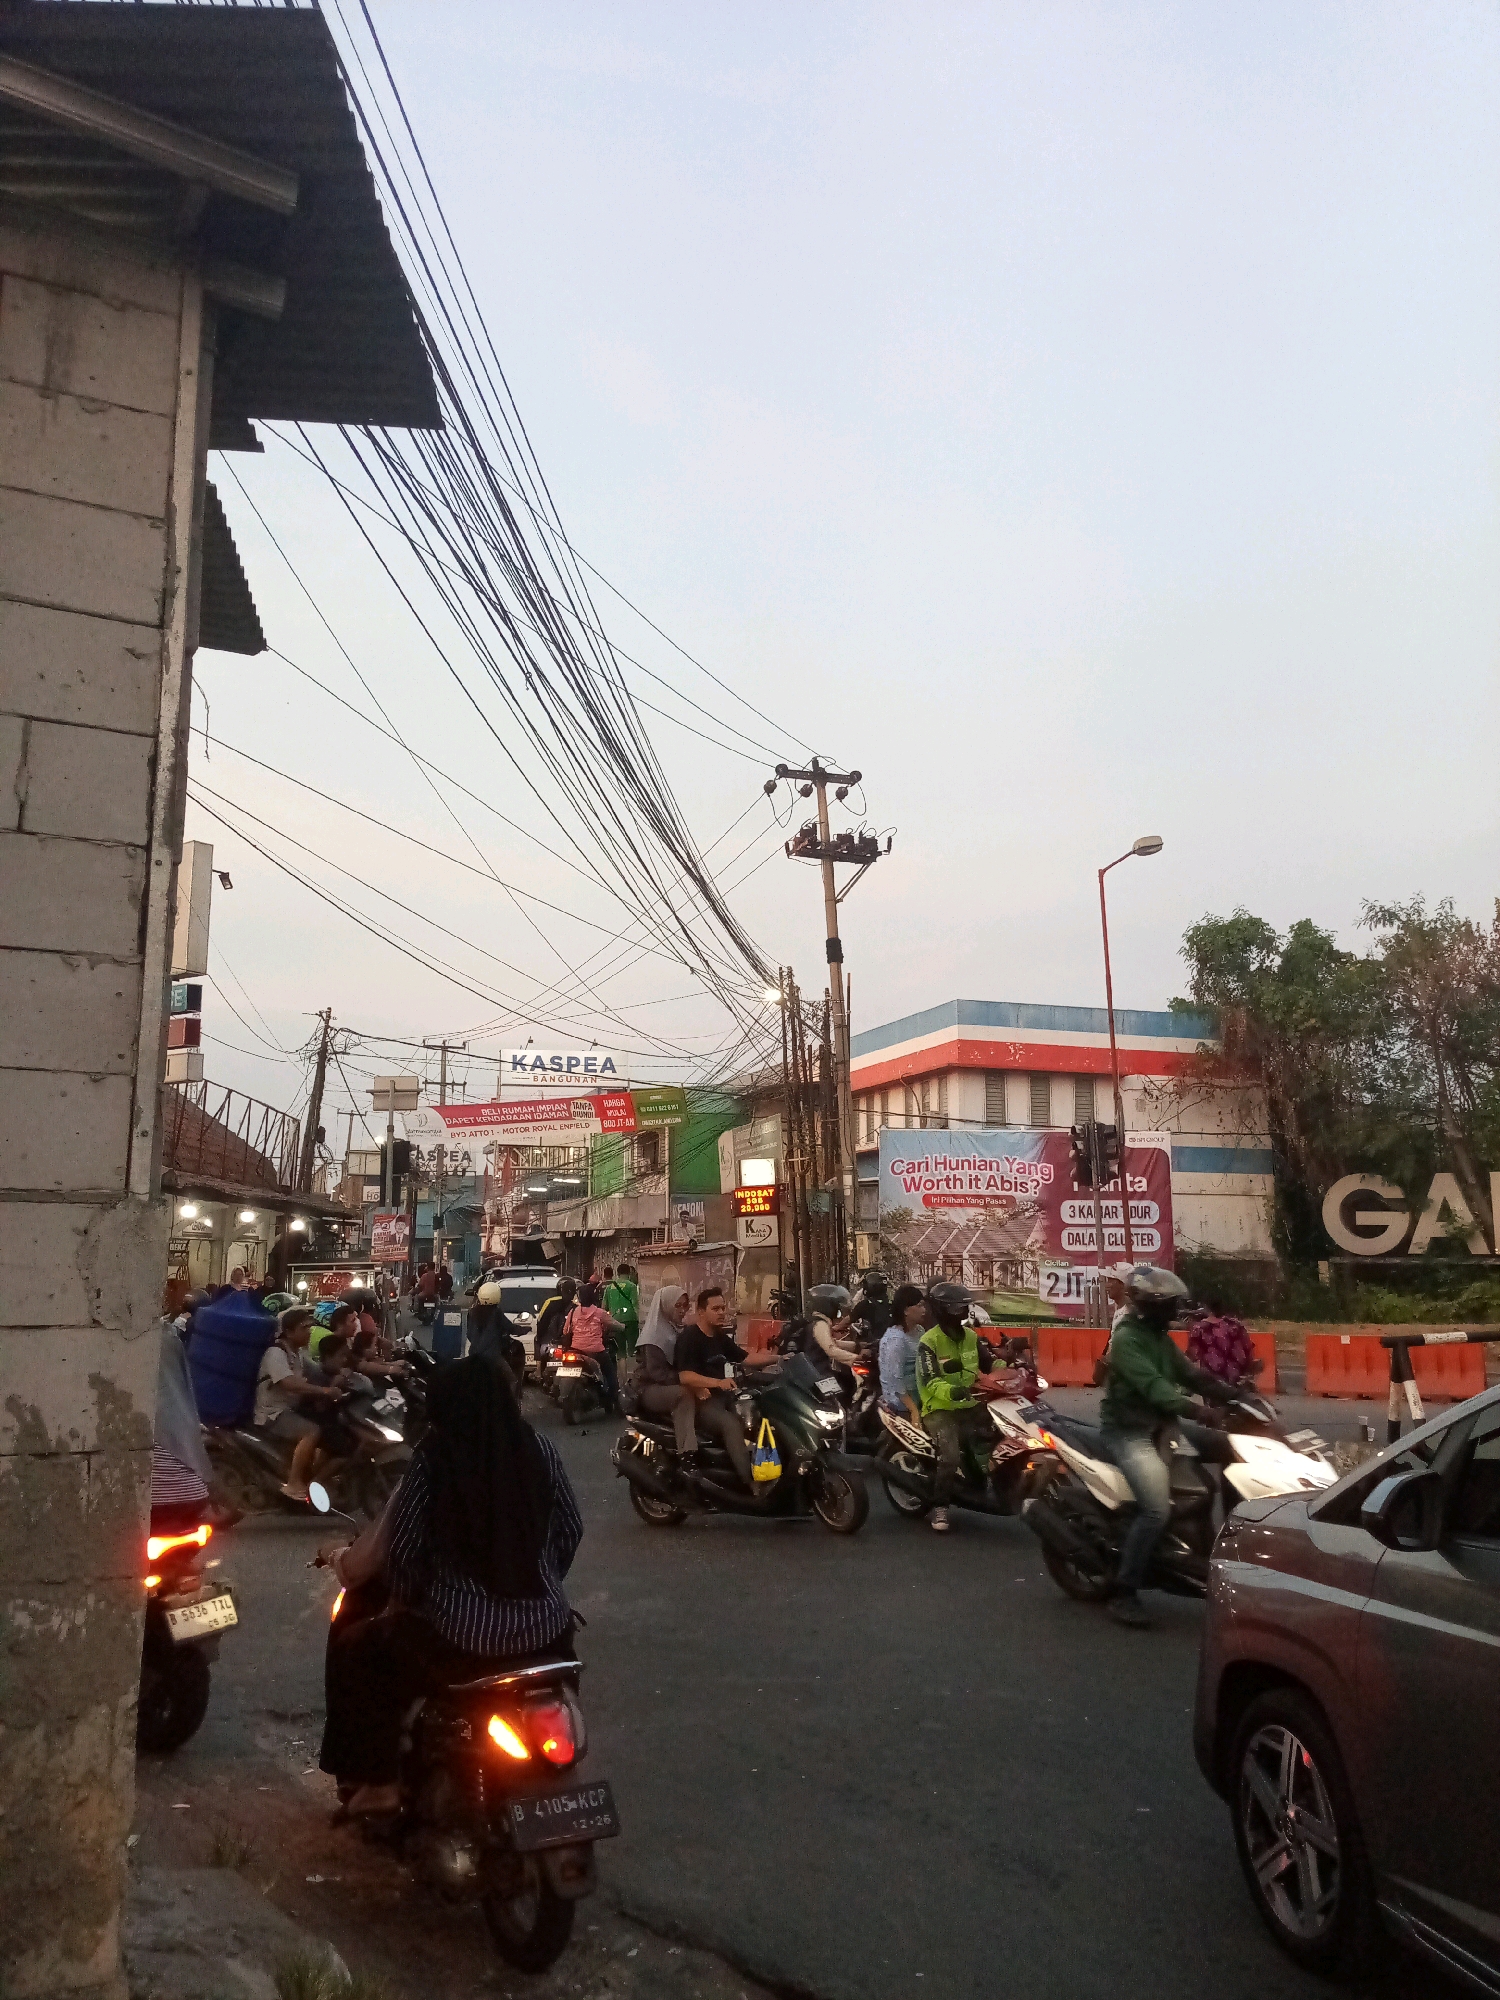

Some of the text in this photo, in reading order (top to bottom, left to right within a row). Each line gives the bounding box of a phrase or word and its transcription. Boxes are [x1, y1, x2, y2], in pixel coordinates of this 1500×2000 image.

[512, 1054, 617, 1074] KASPEA
[533, 1075, 597, 1084] BANGUNAN
[481, 1102, 568, 1116] BELI RUMAH IMPIAN
[571, 1101, 593, 1110] TANPA
[602, 1099, 626, 1108] HARGA
[445, 1110, 569, 1125] DAPET KENDARAAN IDAMAN
[606, 1108, 627, 1117] MULAI
[468, 1129, 490, 1138] ATTO
[502, 1125, 530, 1135] MOTOR
[532, 1123, 558, 1133] ROYAL
[559, 1121, 590, 1131] ENFIELD
[410, 1150, 472, 1162] ASPEA
[890, 1154, 1052, 1182] Cari Hunian Yang
[902, 1173, 1041, 1195] Worth it Abis?
[734, 1188, 775, 1199] INDOSAT
[941, 1196, 965, 1204] Pilihan
[966, 1196, 984, 1206] Yang
[1068, 1204, 1076, 1219] 3
[1120, 1205, 1151, 1219] DUR
[1322, 1171, 1500, 1256] GA
[1046, 1271, 1060, 1298] 2
[969, 1310, 976, 1320] 9
[168, 1613, 177, 1626] B
[211, 1599, 232, 1612] TXL
[513, 1788, 606, 1822] B 4105 KCP
